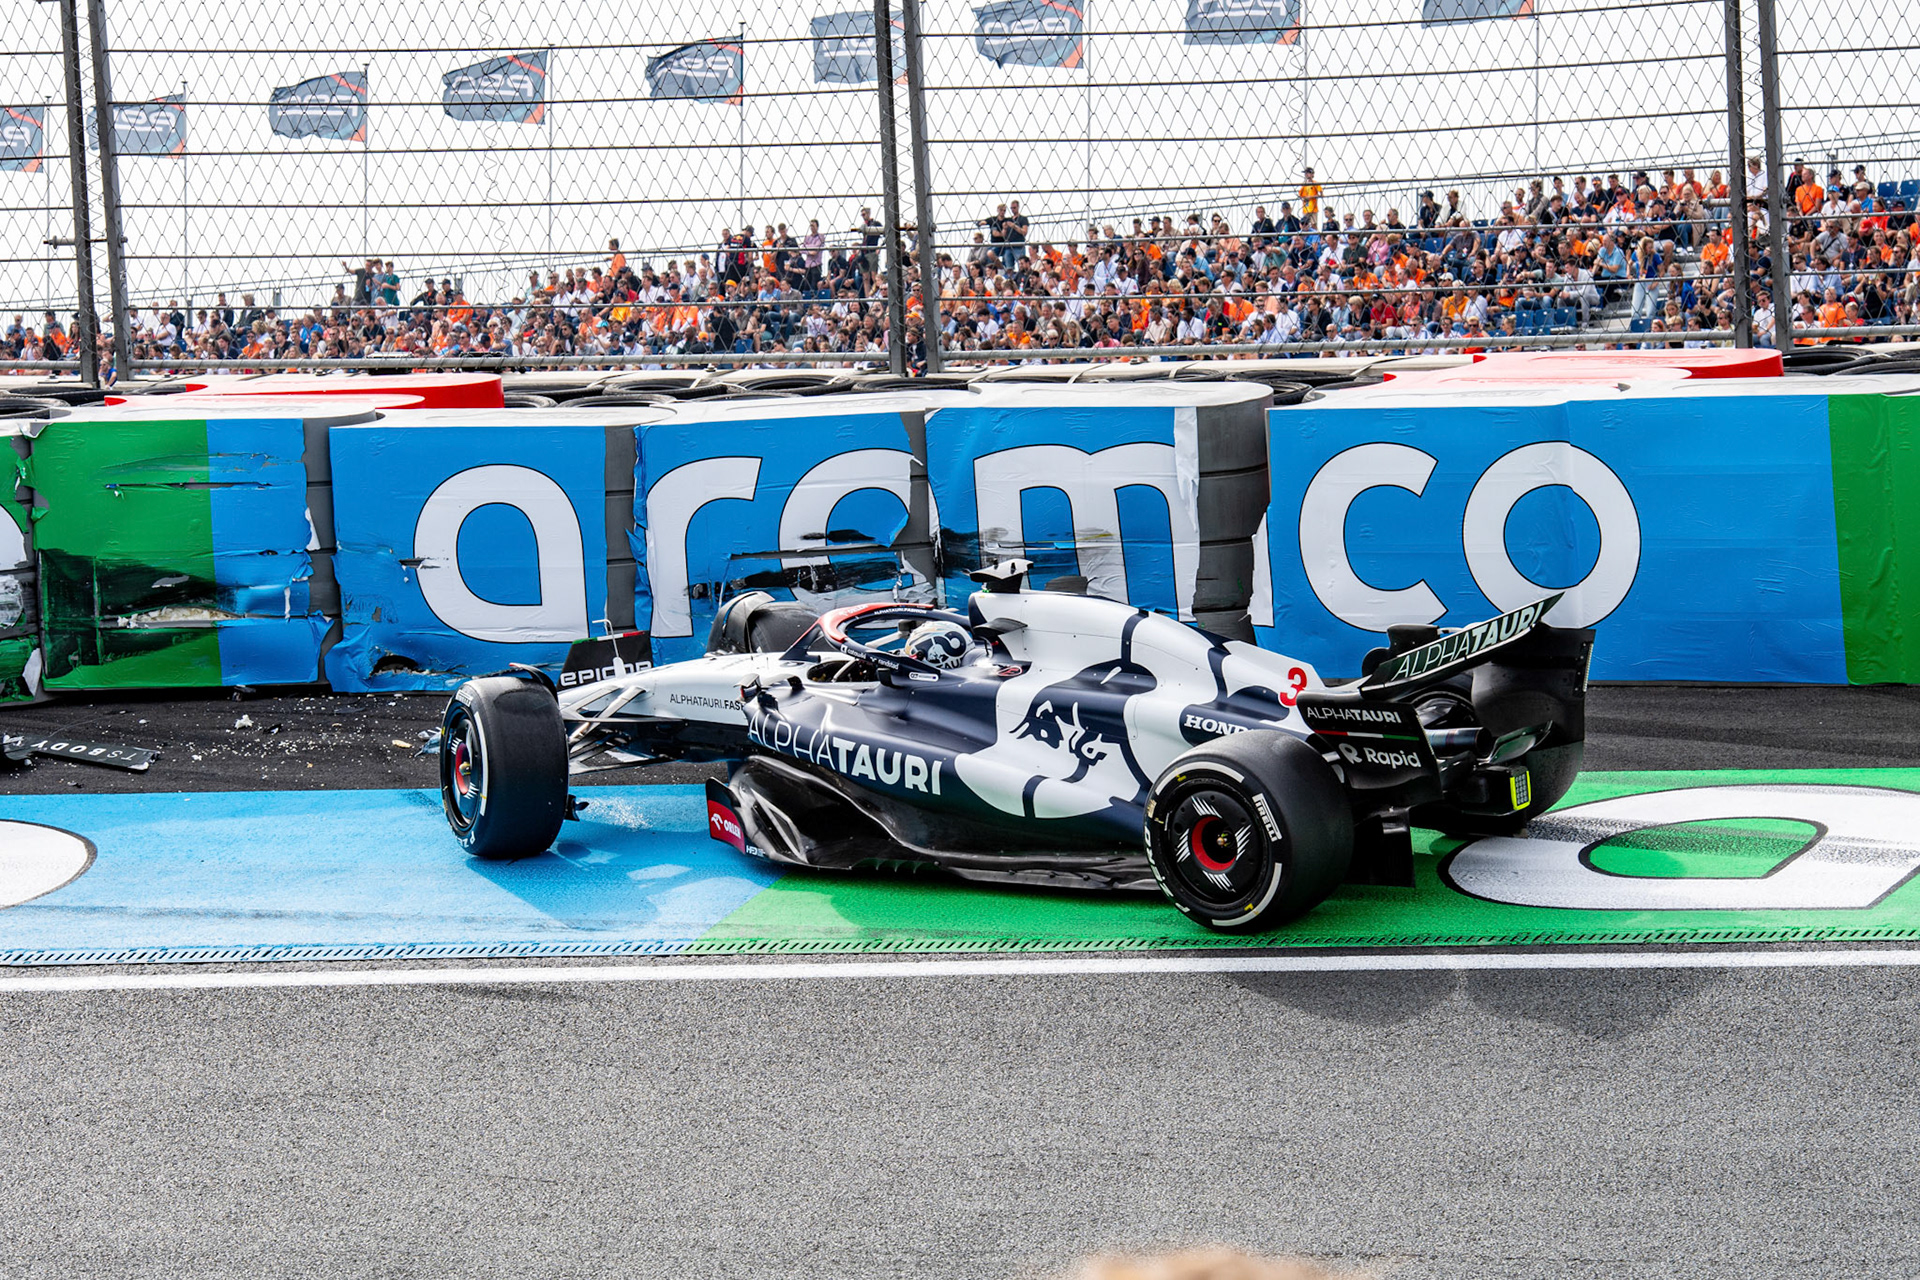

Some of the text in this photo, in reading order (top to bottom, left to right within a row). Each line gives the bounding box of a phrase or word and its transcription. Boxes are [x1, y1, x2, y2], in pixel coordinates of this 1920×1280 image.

[1390, 601, 1545, 682] ALPHATAURI
[1279, 667, 1308, 707] 3
[1307, 706, 1402, 724] ALPHATAURI
[748, 710, 943, 796] ALPHATAURI
[1363, 747, 1422, 769] Rapid
[1252, 793, 1283, 842] PIRELLI
